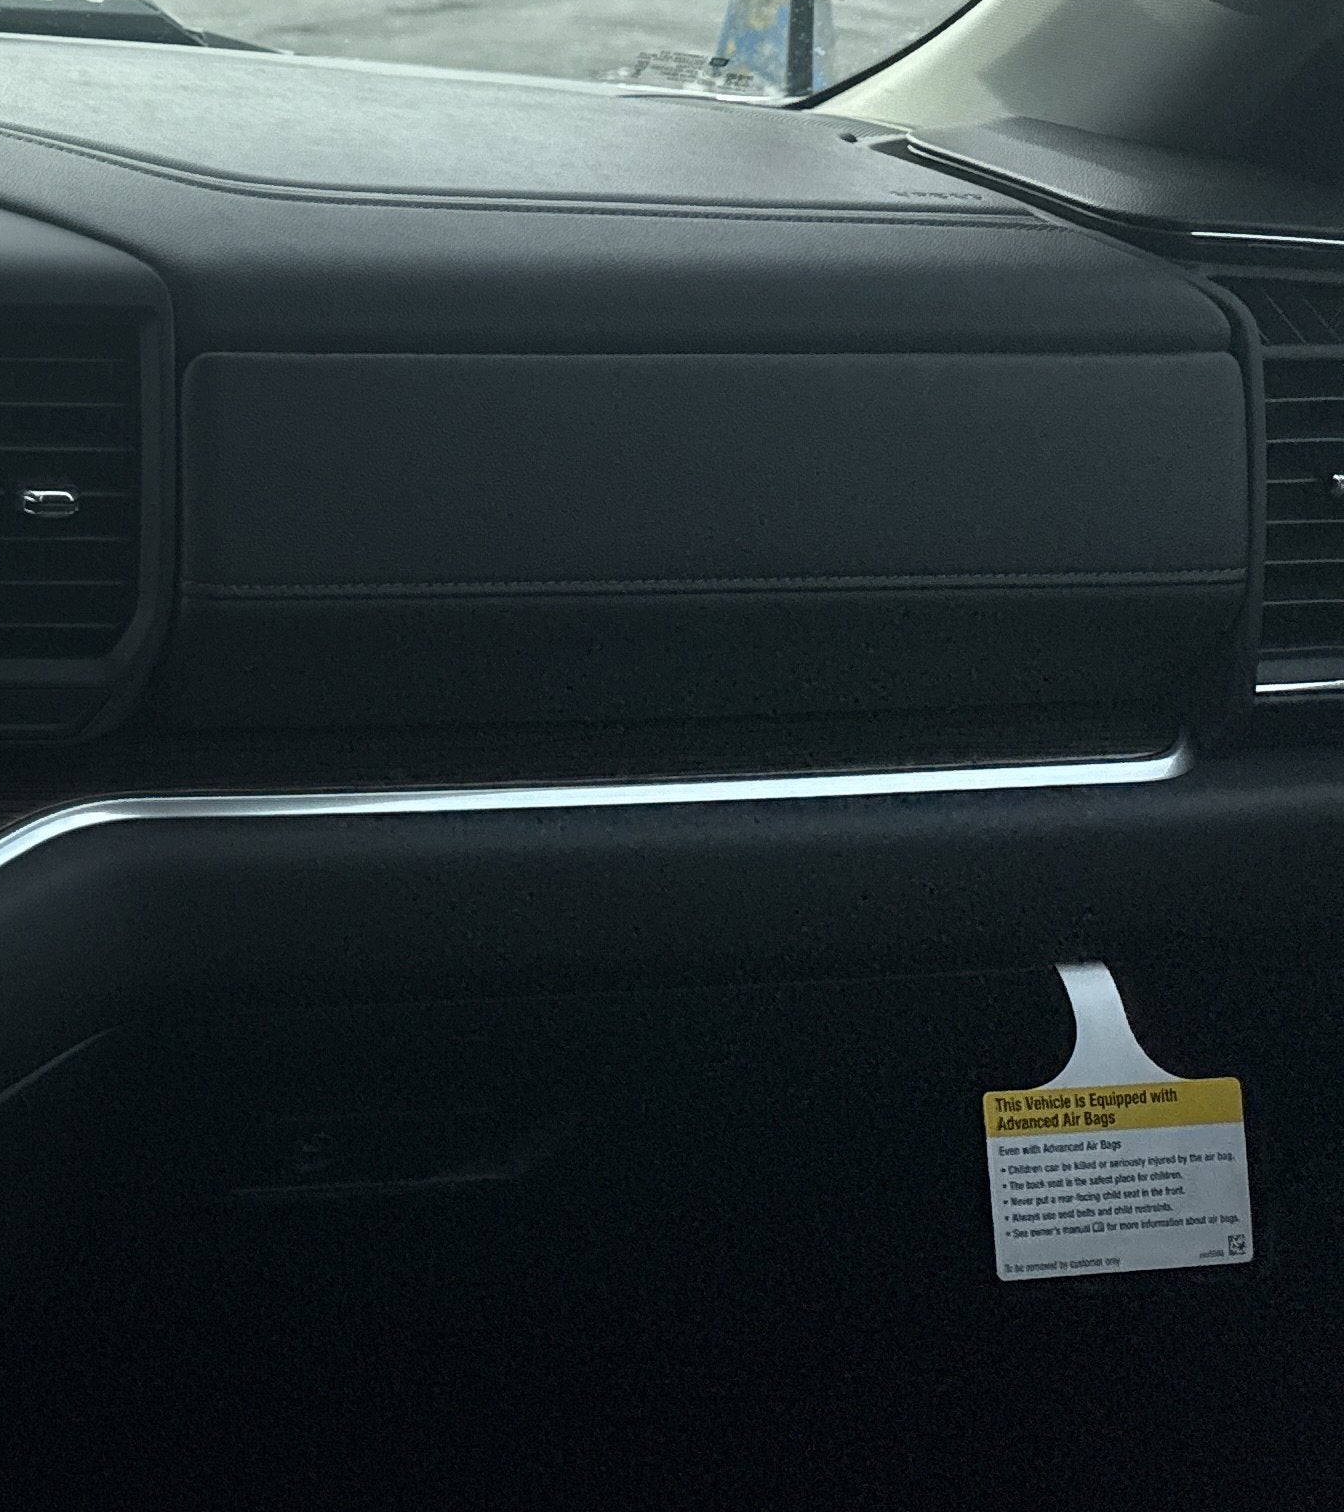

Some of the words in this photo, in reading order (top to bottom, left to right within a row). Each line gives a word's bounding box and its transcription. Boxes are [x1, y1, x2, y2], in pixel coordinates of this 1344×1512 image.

[995, 1097, 1022, 1112] This
[1025, 1094, 1071, 1111] Vehicle
[1089, 1090, 1147, 1109] Equipped
[1150, 1088, 1178, 1103] with
[998, 1113, 1059, 1131] Advanced
[1063, 1112, 1081, 1127] Air
[1084, 1111, 1116, 1128] Bags
[999, 1145, 1020, 1157] Even
[1022, 1144, 1041, 1155] with
[1043, 1142, 1084, 1153] Advanced
[1086, 1140, 1099, 1151] Air
[1100, 1139, 1122, 1152] Bags
[1008, 1164, 1043, 1175] Children
[1044, 1164, 1060, 1173] can
[1062, 1163, 1072, 1172] be
[1074, 1160, 1097, 1170] killed
[1099, 1161, 1107, 1169] or
[1110, 1158, 1146, 1168] seriously
[1148, 1155, 1176, 1166] injured
[1178, 1154, 1187, 1165] by
[1189, 1153, 1202, 1163] the
[1205, 1153, 1215, 1161] air
[1010, 1181, 1024, 1190] The
[1026, 1179, 1045, 1189] back
[1048, 1179, 1064, 1188] seat
[1065, 1178, 1072, 1187] is
[1074, 1177, 1087, 1186] the
[1089, 1175, 1113, 1185] safest
[1115, 1174, 1135, 1185] place
[1138, 1172, 1148, 1182] for
[1150, 1171, 1183, 1181] children.
[1010, 1197, 1033, 1206] Never
[1036, 1196, 1049, 1206] put
[1051, 1196, 1056, 1204] a
[1102, 1190, 1121, 1200] child
[1123, 1189, 1140, 1199] seat
[1142, 1189, 1149, 1198] in
[1151, 1188, 1163, 1197] the
[1165, 1186, 1185, 1196] front.
[1076, 1208, 1096, 1218] belts
[1098, 1206, 1112, 1216] and
[1114, 1205, 1132, 1215] child
[1134, 1203, 1173, 1214] restraints.
[1012, 1229, 1029, 1239] See
[1030, 1227, 1061, 1237] owner's
[1062, 1224, 1091, 1235] manual
[1106, 1222, 1117, 1231] for
[1120, 1222, 1139, 1230] more
[1140, 1218, 1183, 1228] information
[1185, 1216, 1206, 1225] about
[1208, 1215, 1218, 1224] air
[1220, 1214, 1240, 1224] bags.
